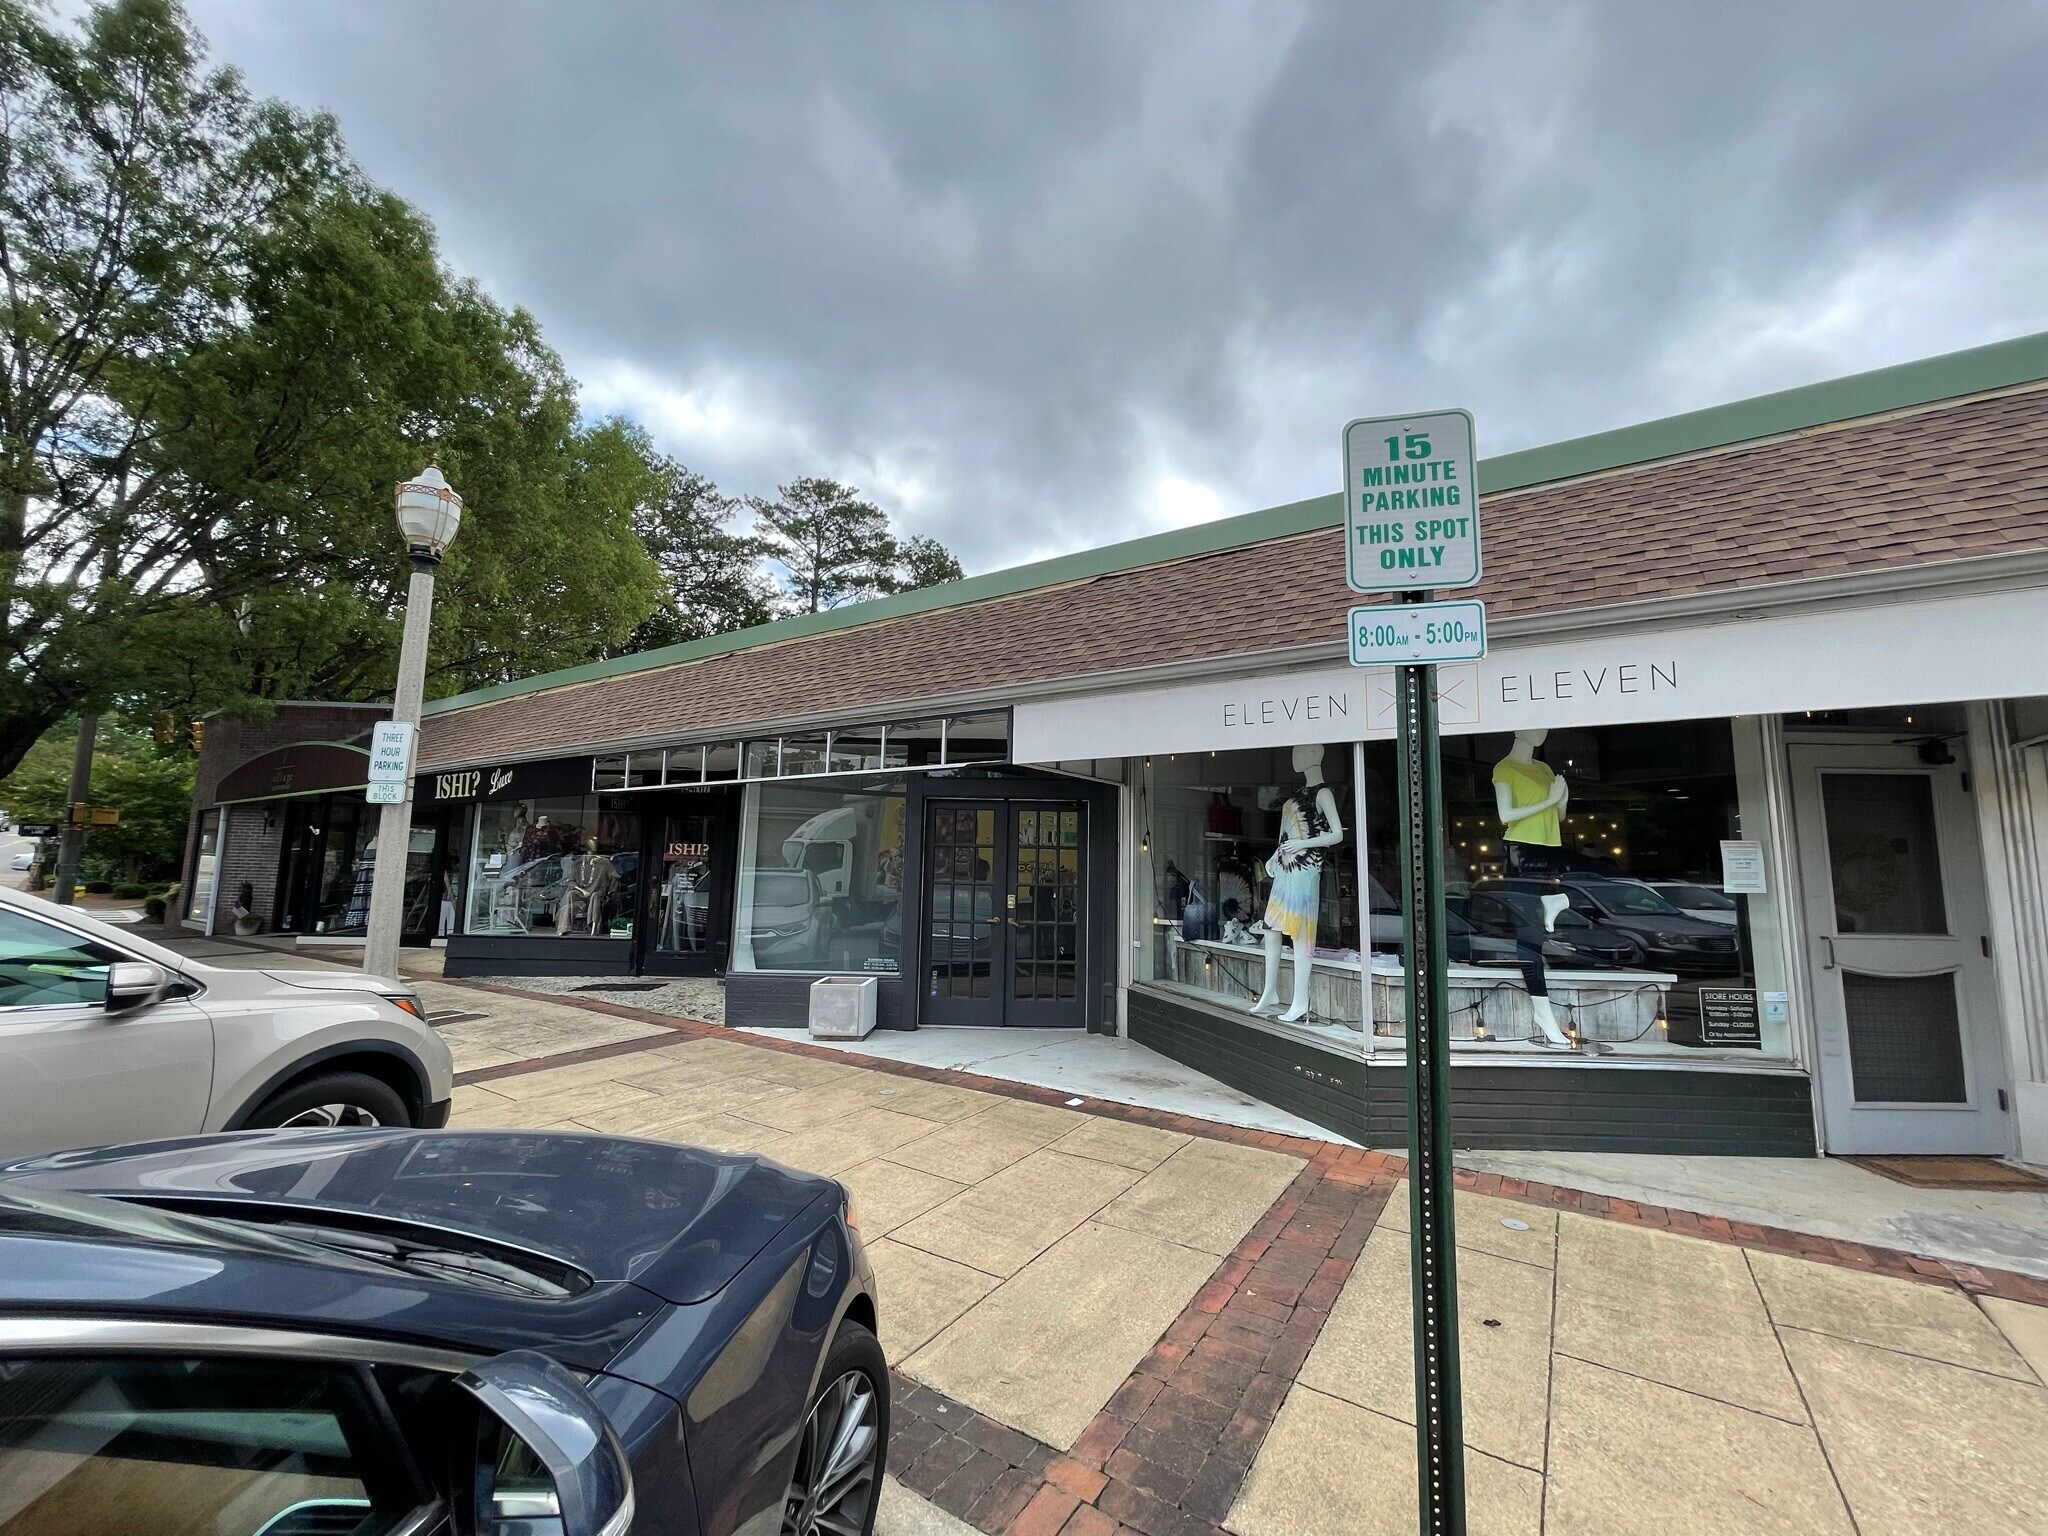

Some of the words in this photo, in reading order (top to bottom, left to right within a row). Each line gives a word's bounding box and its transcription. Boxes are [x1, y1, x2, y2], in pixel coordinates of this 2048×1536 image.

[1384, 432, 1432, 462] 15
[1363, 459, 1457, 488] MINUTE
[1362, 484, 1461, 513] PARKING
[1356, 522, 1404, 545] THIS
[1415, 517, 1470, 542] SPOT
[1380, 545, 1446, 570] ONLY
[1359, 624, 1409, 648] 8:00AM
[1426, 620, 1478, 645] 5:00PM
[1223, 692, 1347, 727] ELEVEN
[1501, 660, 1677, 703] ELEVEN
[382, 732, 404, 743] THREE
[380, 747, 401, 757] HOUR
[373, 760, 404, 771] PARKING
[373, 792, 397, 800] BLOCK
[378, 784, 395, 793] THIS
[434, 770, 481, 799] ISHI?
[668, 842, 709, 856] ISHI?
[1704, 992, 1727, 1000] STORE
[1728, 993, 1753, 1001] HOURS
